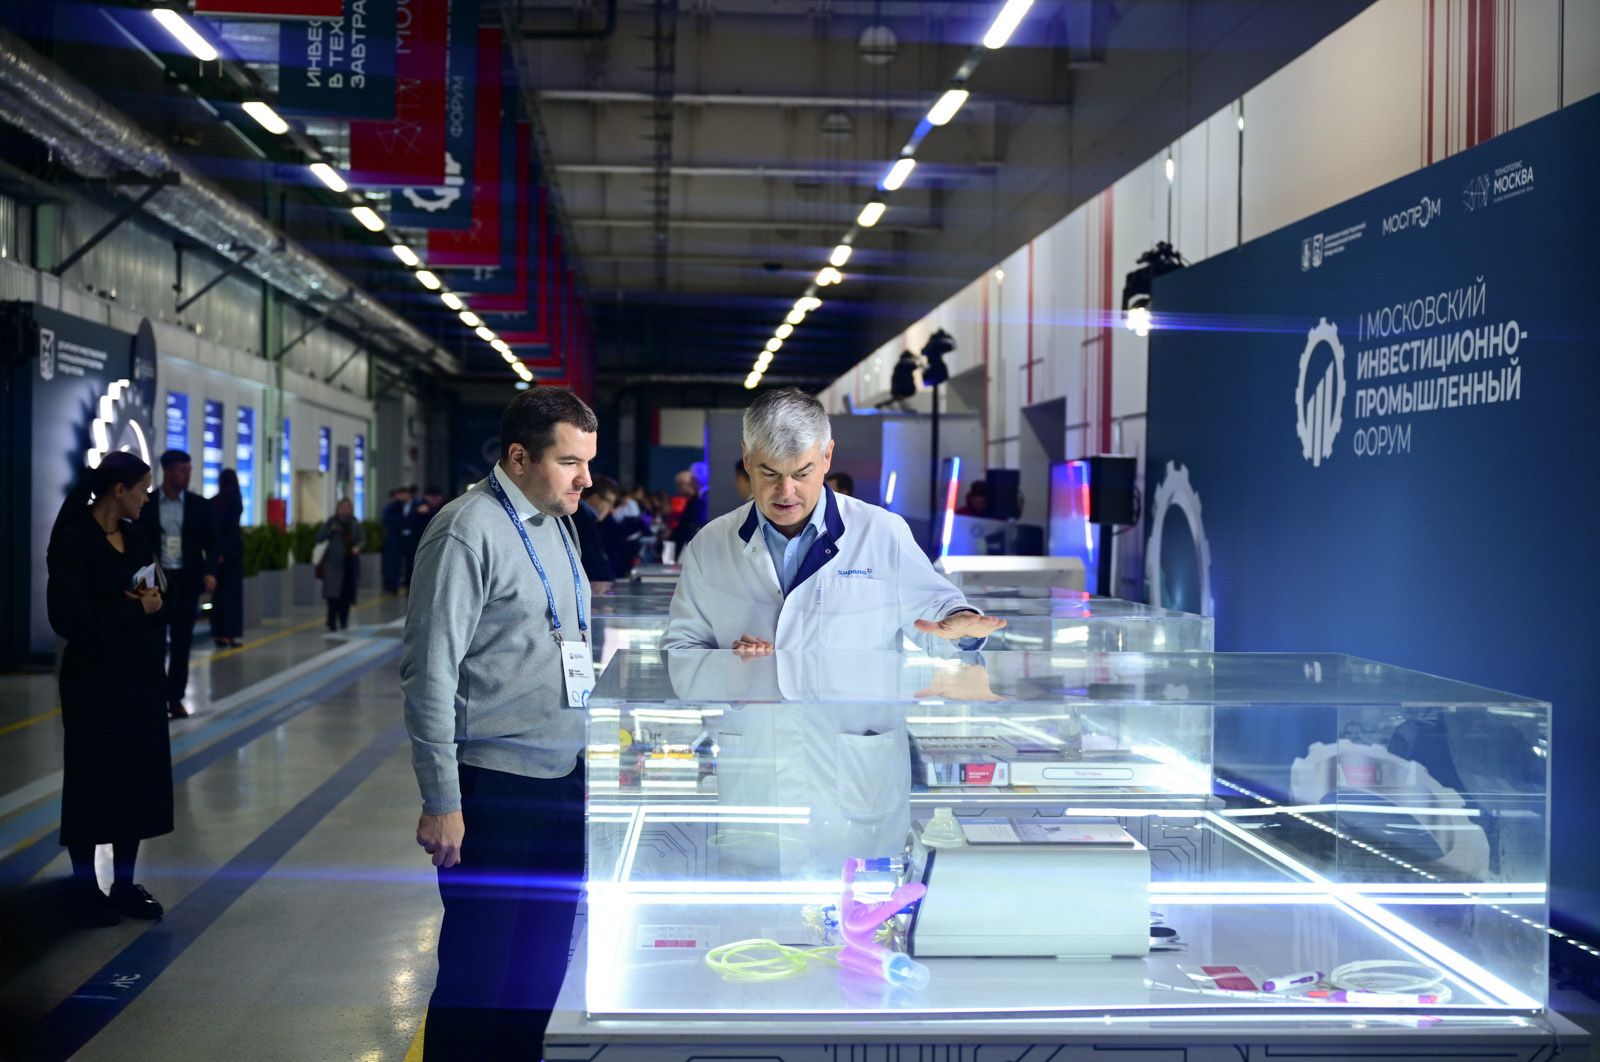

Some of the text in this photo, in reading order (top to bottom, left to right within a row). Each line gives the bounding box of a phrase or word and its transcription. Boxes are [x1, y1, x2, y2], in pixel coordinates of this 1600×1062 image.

[350, 0, 366, 88] ЗАВТРА
[328, 73, 343, 88] В
[1494, 166, 1534, 195] МОСКВА
[1382, 196, 1441, 236] МОСПРОМ
[1367, 275, 1486, 338] МОСКОВСКИЙ
[1357, 320, 1528, 381] ИНВЕСТИЦИОННО-
[1355, 358, 1522, 418] ПРОМЫШЛЕННЫЙ
[1353, 423, 1411, 457] ФОРУМ
